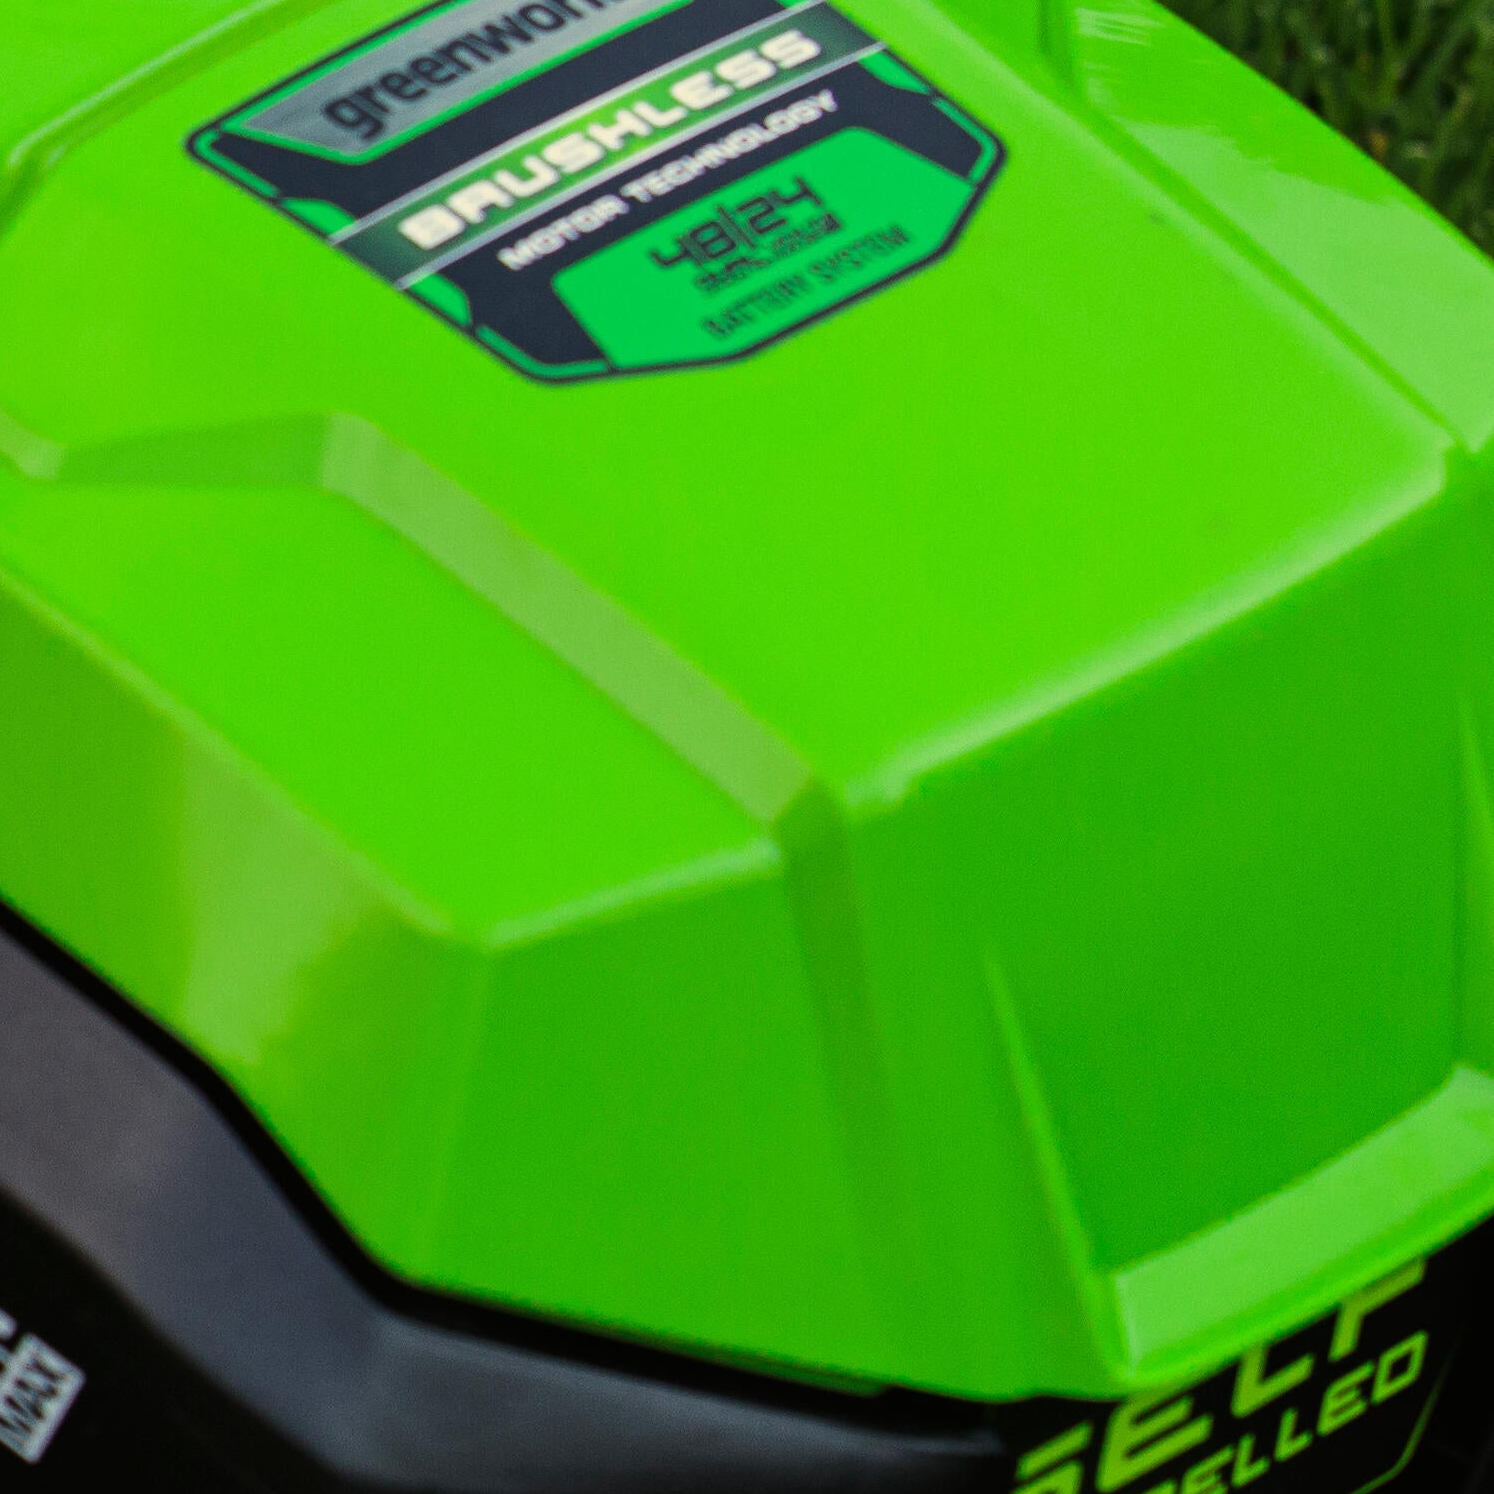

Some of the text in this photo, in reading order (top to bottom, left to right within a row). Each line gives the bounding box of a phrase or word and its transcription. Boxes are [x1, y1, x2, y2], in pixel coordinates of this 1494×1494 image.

[396, 28, 823, 251] BRUSHLESS
[497, 195, 632, 271] MOTOR
[620, 88, 840, 204] TECHNOLOGY
